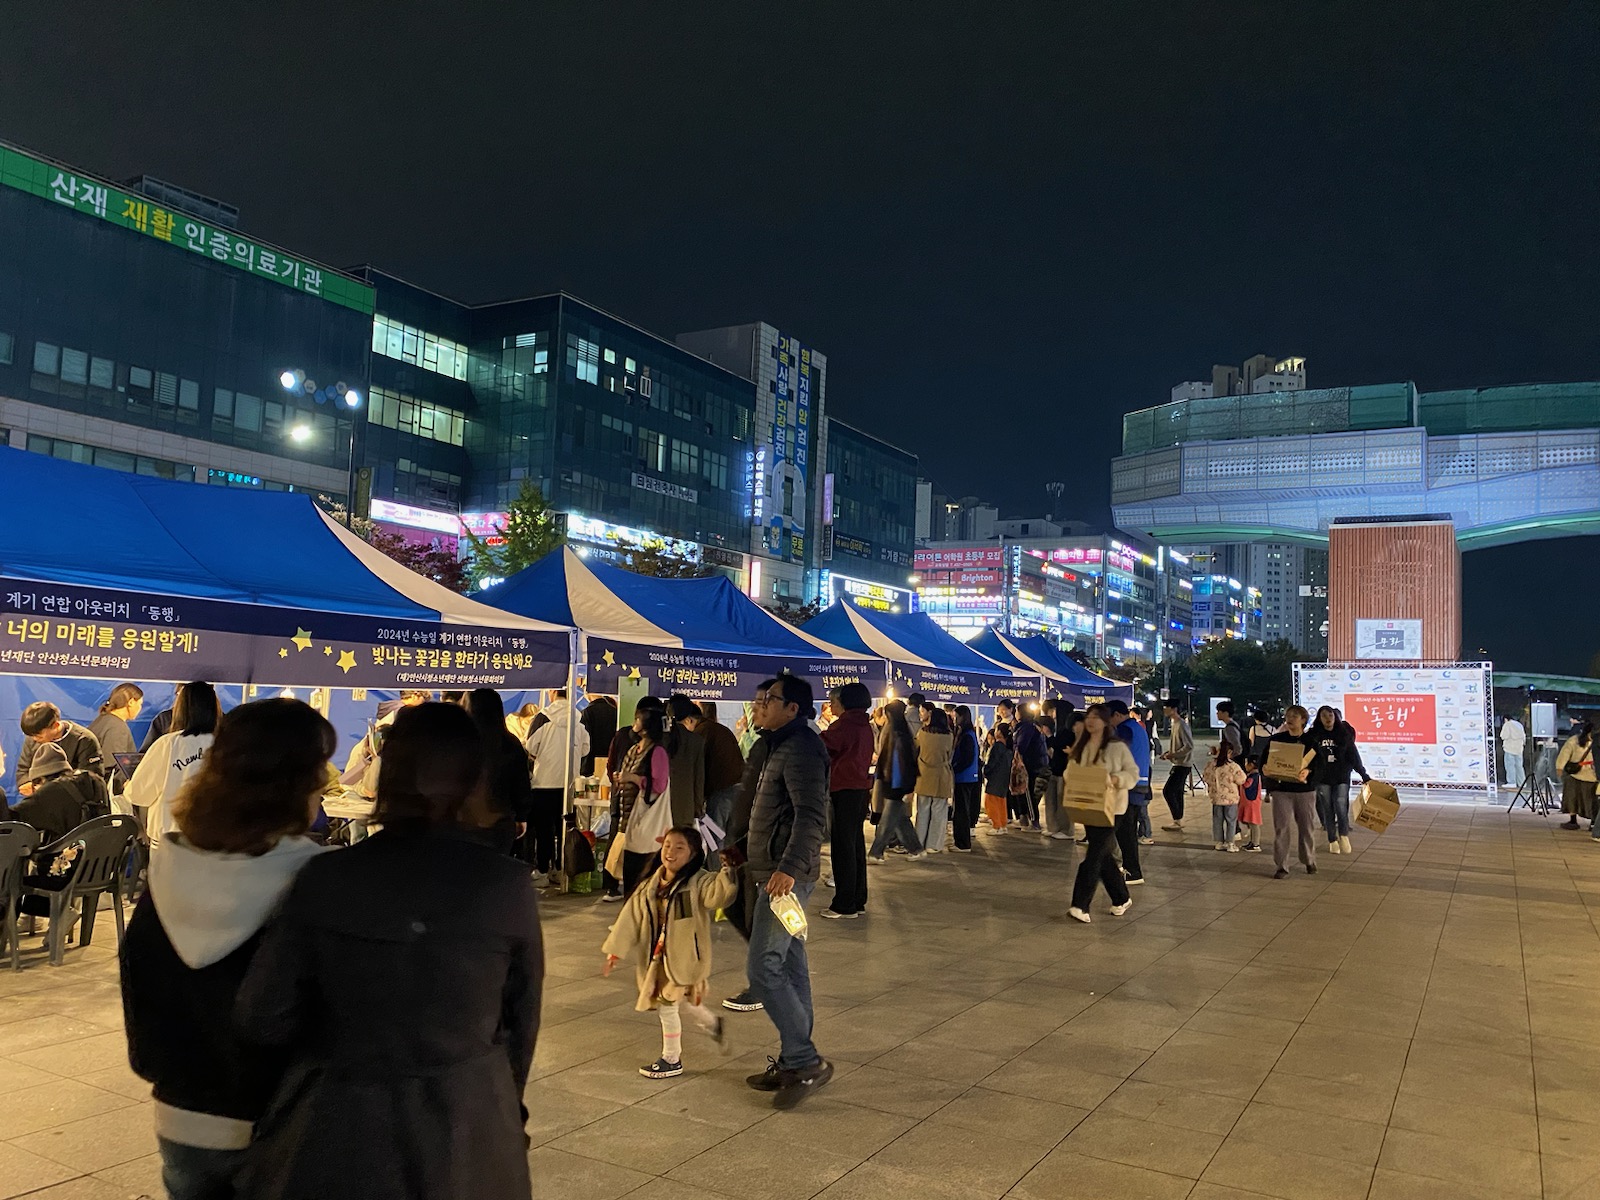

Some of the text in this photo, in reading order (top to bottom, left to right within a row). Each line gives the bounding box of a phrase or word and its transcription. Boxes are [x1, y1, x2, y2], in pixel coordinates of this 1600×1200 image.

[50, 172, 323, 295] 산재 재활 인증의료기관
[964, 551, 985, 561] 초등부
[986, 551, 1001, 561] 모집
[961, 573, 993, 584] Brighton
[6, 591, 37, 611] 계기
[41, 595, 71, 613] 연합
[74, 599, 130, 619] 아웃리치
[7, 619, 200, 655] 너의 미래를 응원할게!
[377, 628, 411, 642] 2024년
[411, 631, 437, 645] 수능일
[438, 633, 455, 646] 계기
[456, 635, 472, 648] 연합
[473, 635, 503, 649] 아웃리치
[37, 652, 131, 669] 안산청소년문화의집
[372, 646, 533, 671] 빛나는 꽃길을 환타가 응원해요
[657, 667, 738, 687] 나의 권리는 내가 지킨다
